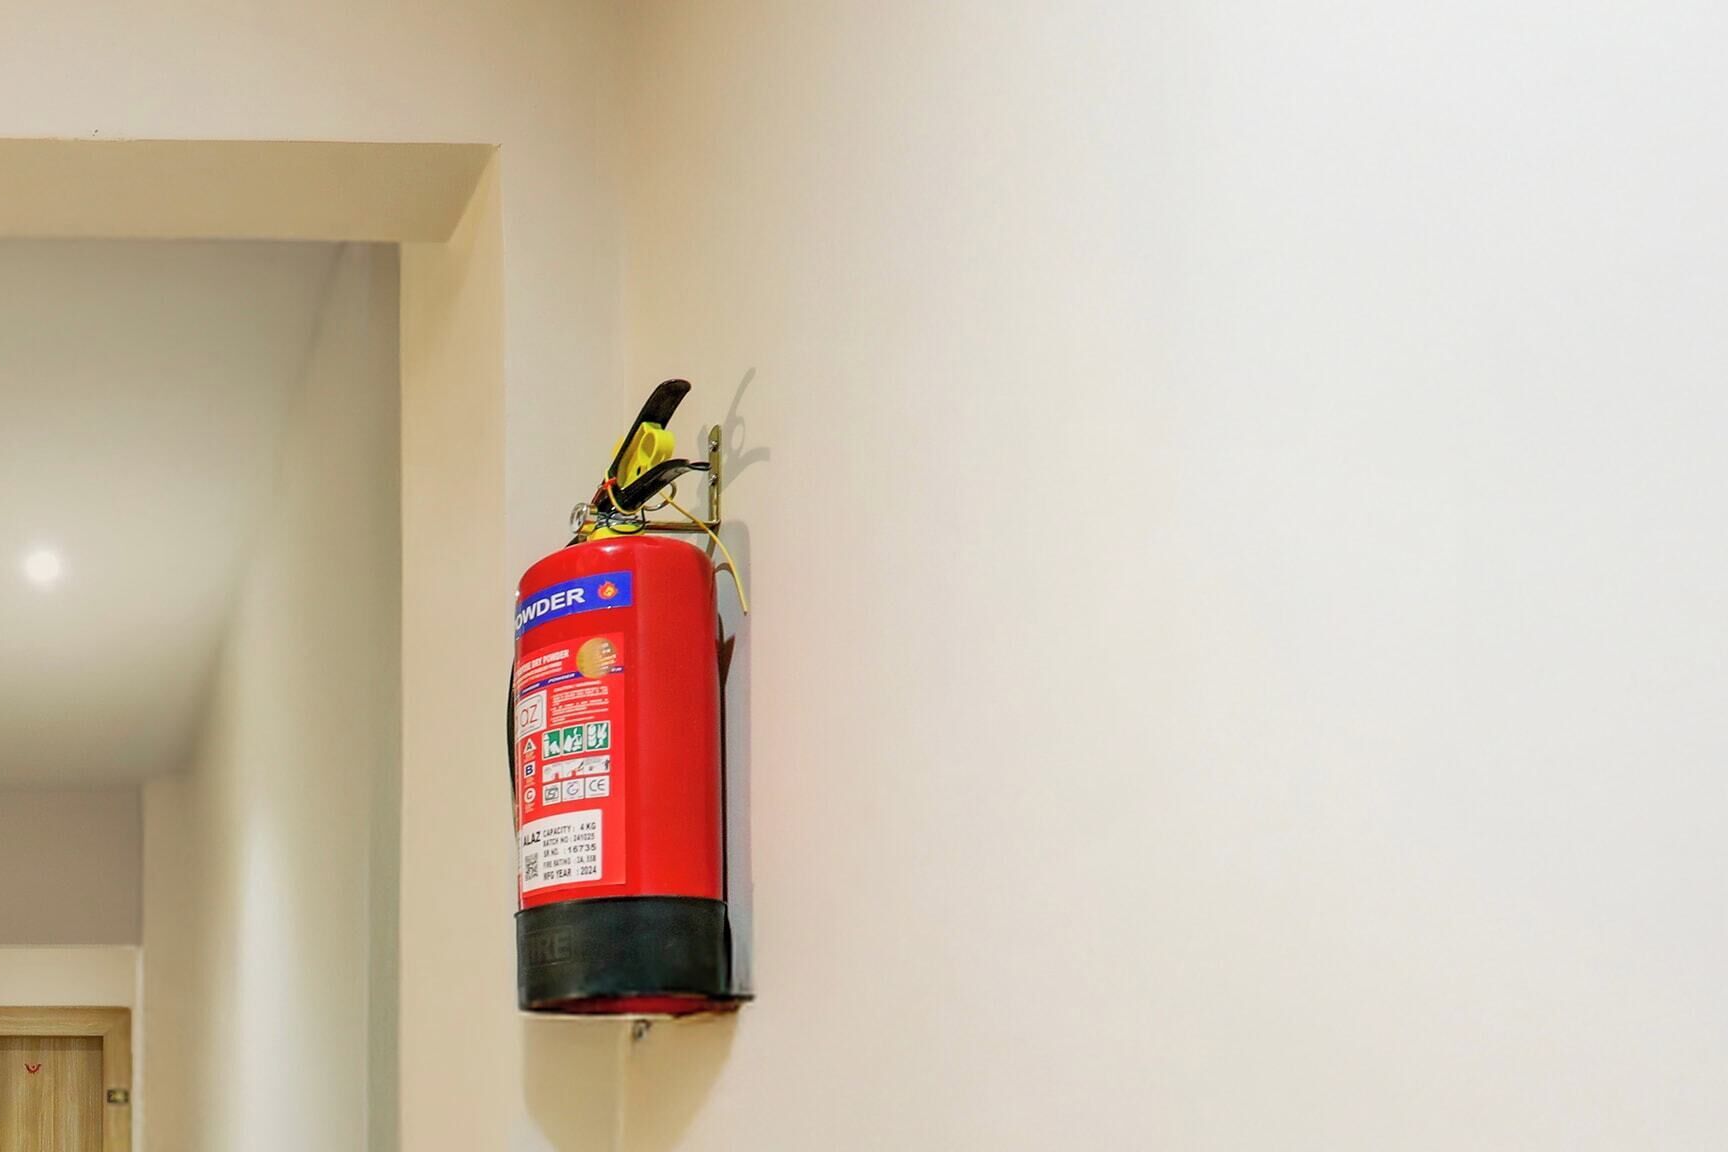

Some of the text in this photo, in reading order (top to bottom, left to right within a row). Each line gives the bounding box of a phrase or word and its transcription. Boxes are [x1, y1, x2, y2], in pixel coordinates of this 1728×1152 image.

[586, 822, 597, 831] KG
[568, 843, 597, 853] 16735
[556, 868, 571, 879] YEAR
[580, 865, 597, 875] 2024
